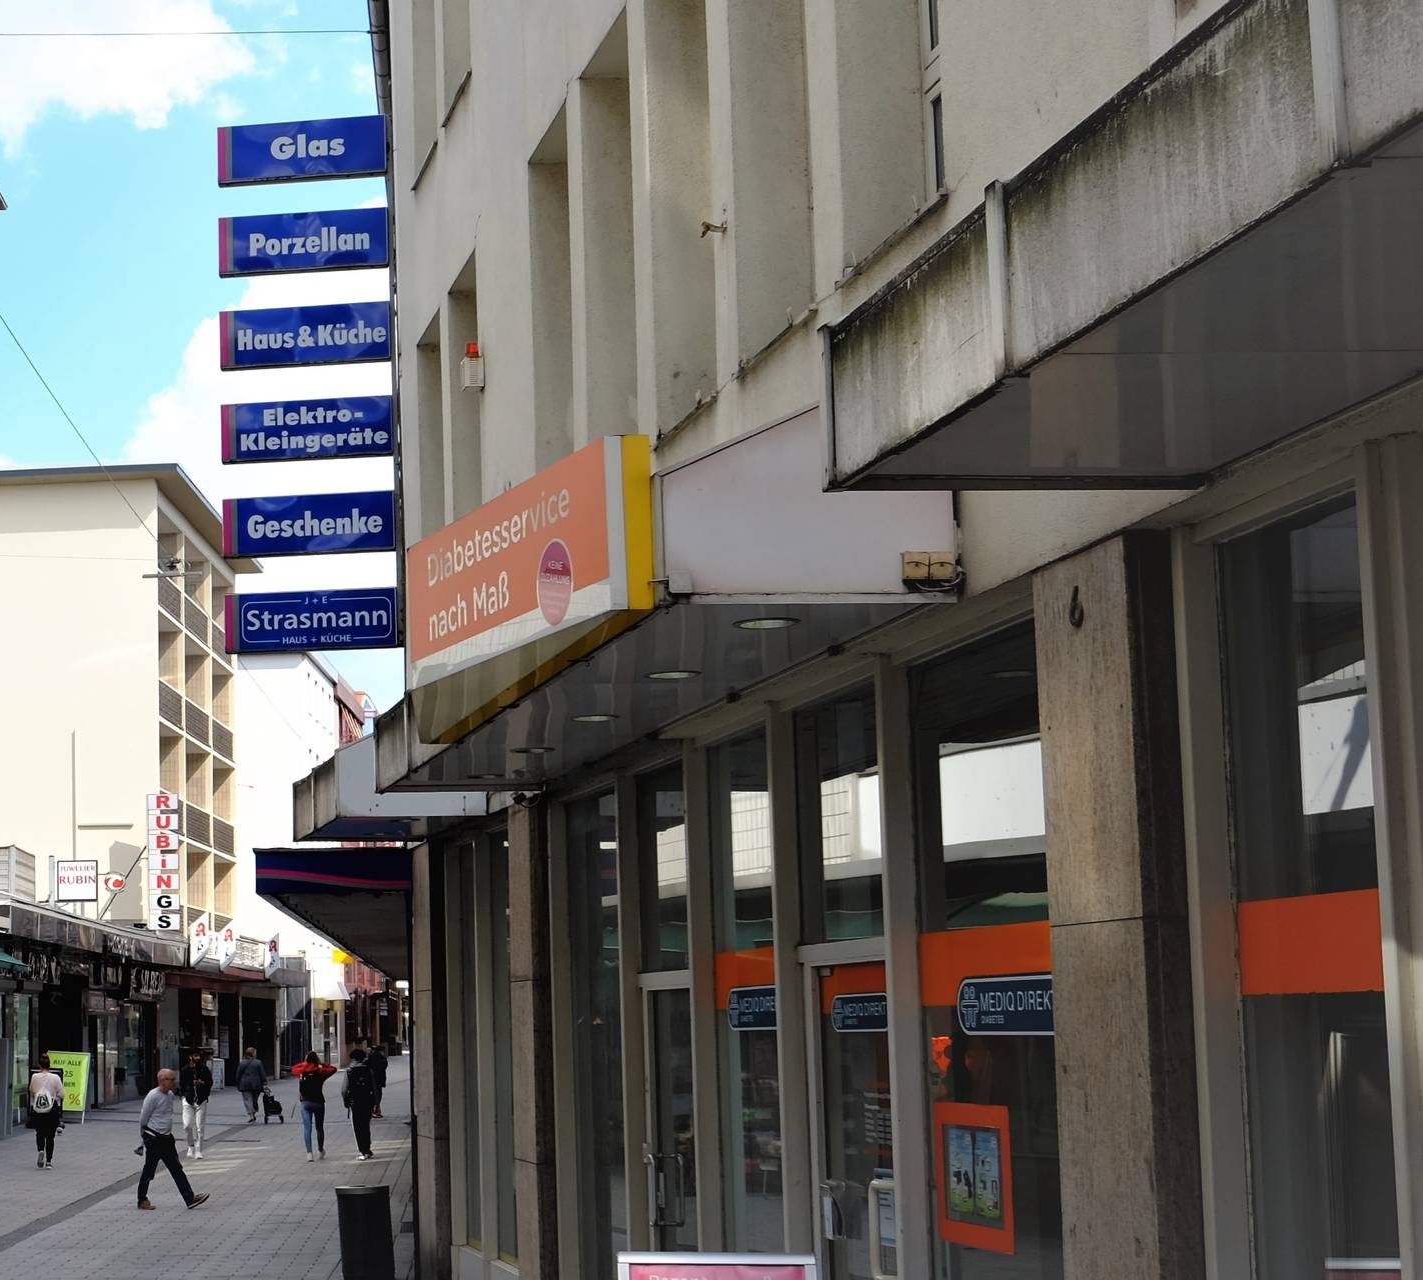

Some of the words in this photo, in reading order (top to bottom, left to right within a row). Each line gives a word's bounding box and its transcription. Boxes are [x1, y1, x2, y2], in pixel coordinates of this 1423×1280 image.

[270, 133, 345, 160] Glas
[249, 226, 370, 256] Porzellan
[263, 406, 363, 426] Elektro-
[240, 428, 389, 452] Kleingeräte
[247, 508, 382, 539] Geschenke
[427, 488, 570, 587] Diabetesservice
[429, 594, 467, 641] nach
[473, 571, 510, 622] Maß
[1069, 585, 1084, 628] 6
[246, 609, 388, 632] Strasmann
[282, 635, 307, 645] HAUS
[320, 633, 352, 643] KÜCHE
[59, 876, 96, 885] RUBIN
[980, 991, 1015, 1012] MEDIQ
